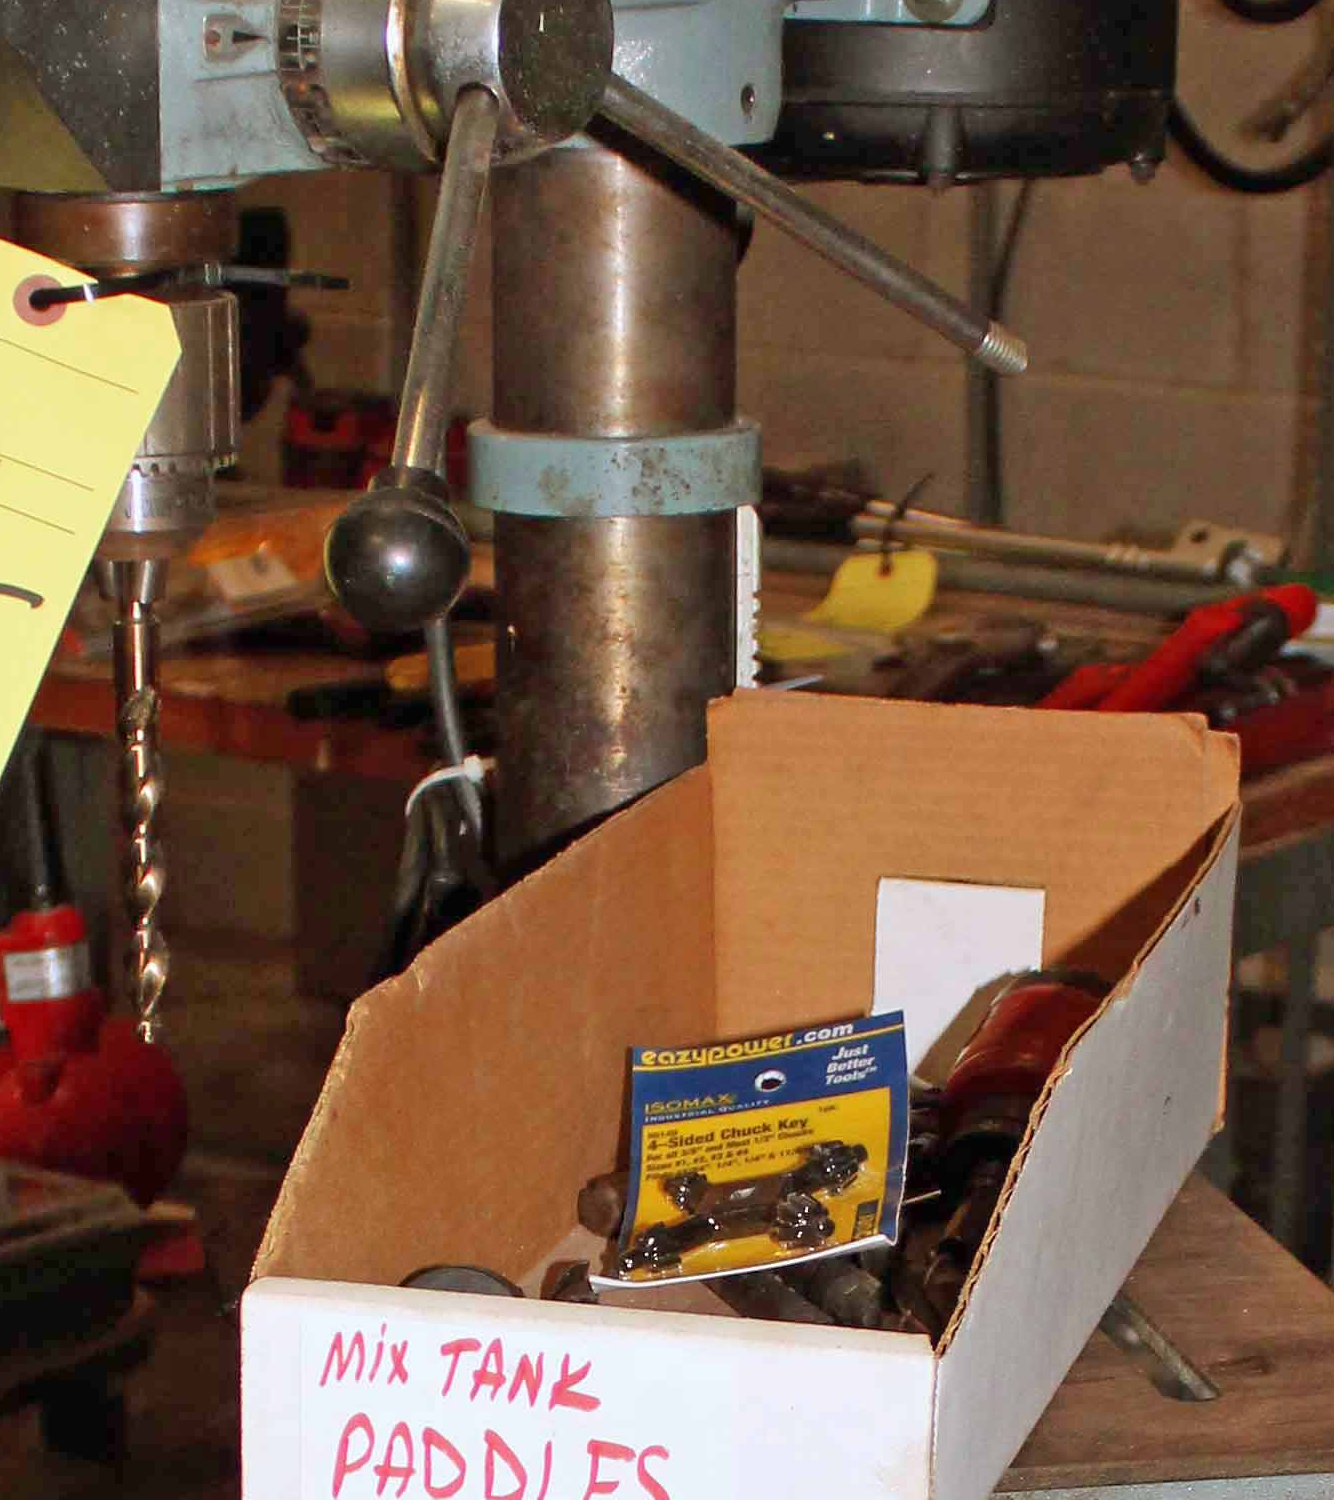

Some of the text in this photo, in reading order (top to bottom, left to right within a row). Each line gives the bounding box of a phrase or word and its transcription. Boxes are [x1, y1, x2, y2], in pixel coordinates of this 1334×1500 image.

[640, 1023, 855, 1068] eazypower.com
[831, 1044, 870, 1061] Just
[825, 1055, 876, 1075] Better
[644, 1093, 735, 1115] ISOMAX
[644, 1098, 771, 1124] INDUSTRIAL QUALITY
[720, 1122, 773, 1140] Chuck
[778, 1117, 809, 1131] Key
[440, 1336, 602, 1412] TANK
